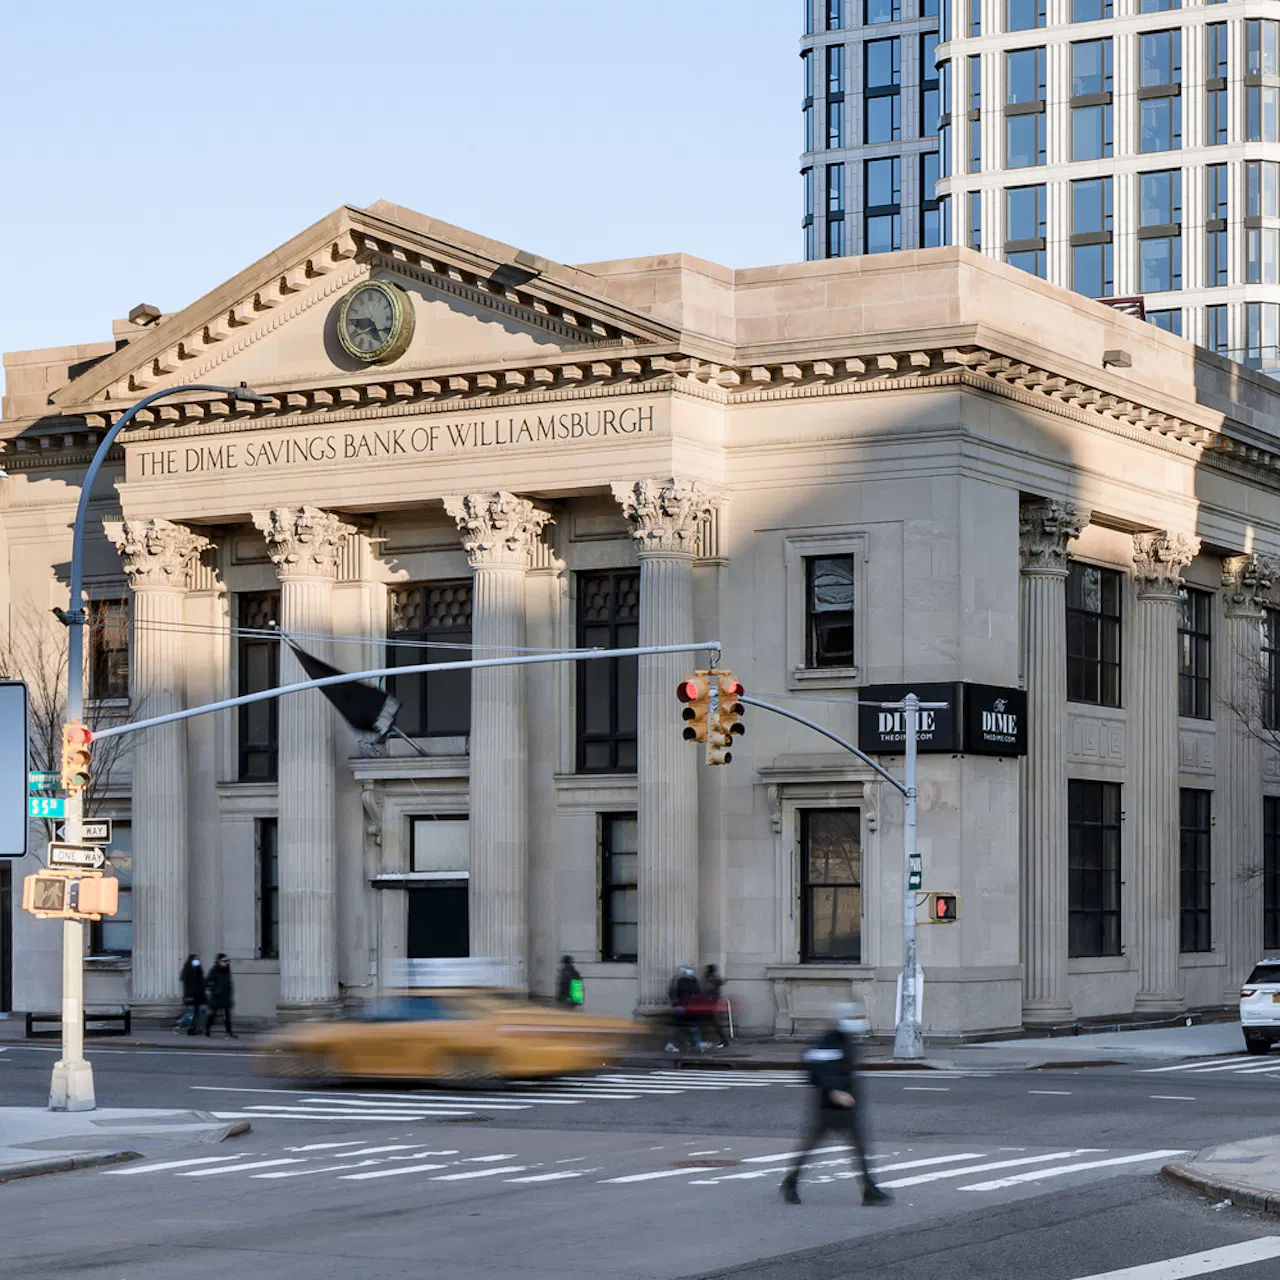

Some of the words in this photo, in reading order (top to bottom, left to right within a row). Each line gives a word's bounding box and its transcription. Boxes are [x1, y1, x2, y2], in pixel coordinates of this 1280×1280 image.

[137, 449, 179, 476] THE
[185, 443, 238, 473] DIME
[244, 434, 337, 468] SAVINGS
[343, 427, 407, 458] BANK
[411, 425, 441, 453] OF
[446, 405, 655, 450] WILLIAMSBURGH
[981, 710, 1018, 735] DIME
[880, 733, 933, 742] THEDICOM
[983, 733, 1016, 743] THEDIME.COM
[32, 799, 39, 815] S
[85, 826, 103, 835] WAY
[58, 851, 76, 861] ONE
[84, 851, 102, 861] WAY
